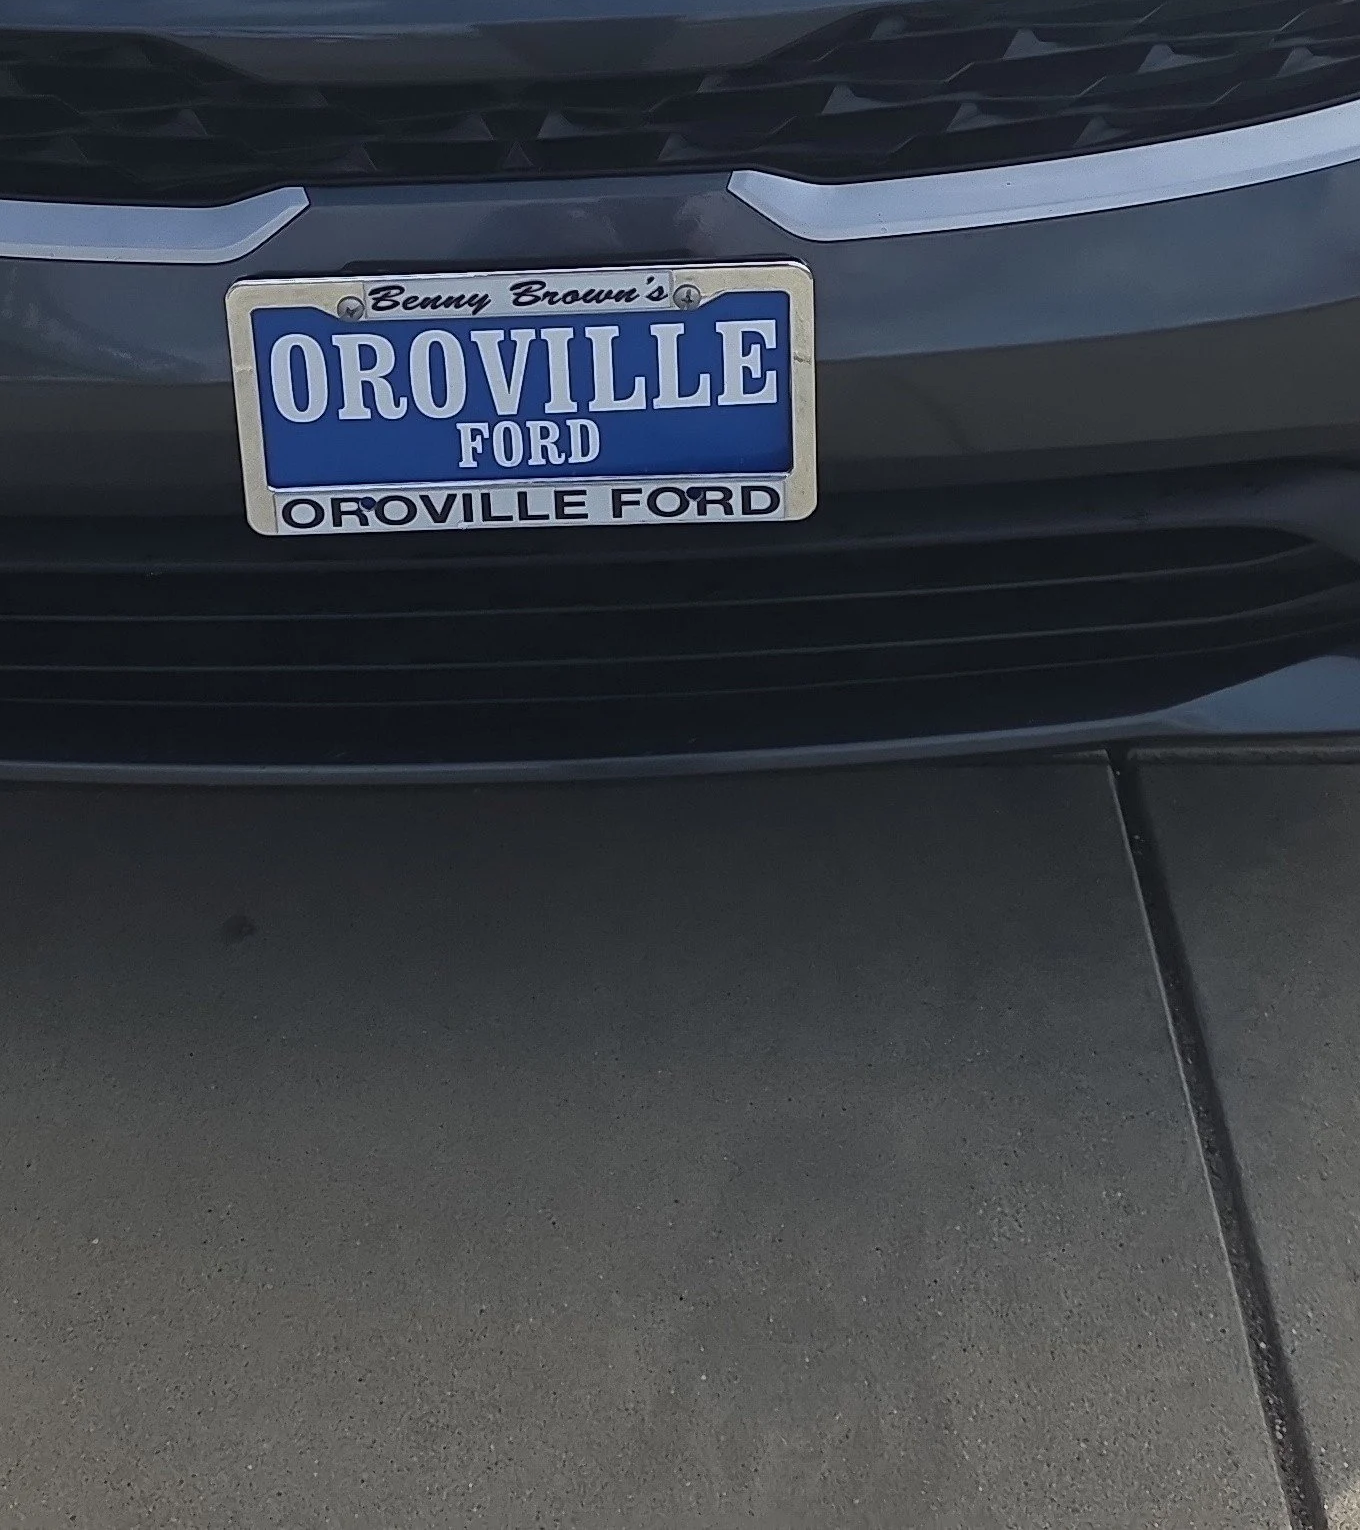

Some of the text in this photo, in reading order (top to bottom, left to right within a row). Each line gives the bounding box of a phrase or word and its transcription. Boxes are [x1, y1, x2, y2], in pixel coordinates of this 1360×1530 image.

[367, 276, 669, 315] Benny Brown's
[270, 318, 778, 424] OROVILLE
[456, 417, 602, 468] FORD
[280, 484, 781, 529] OROVILLE FORD
